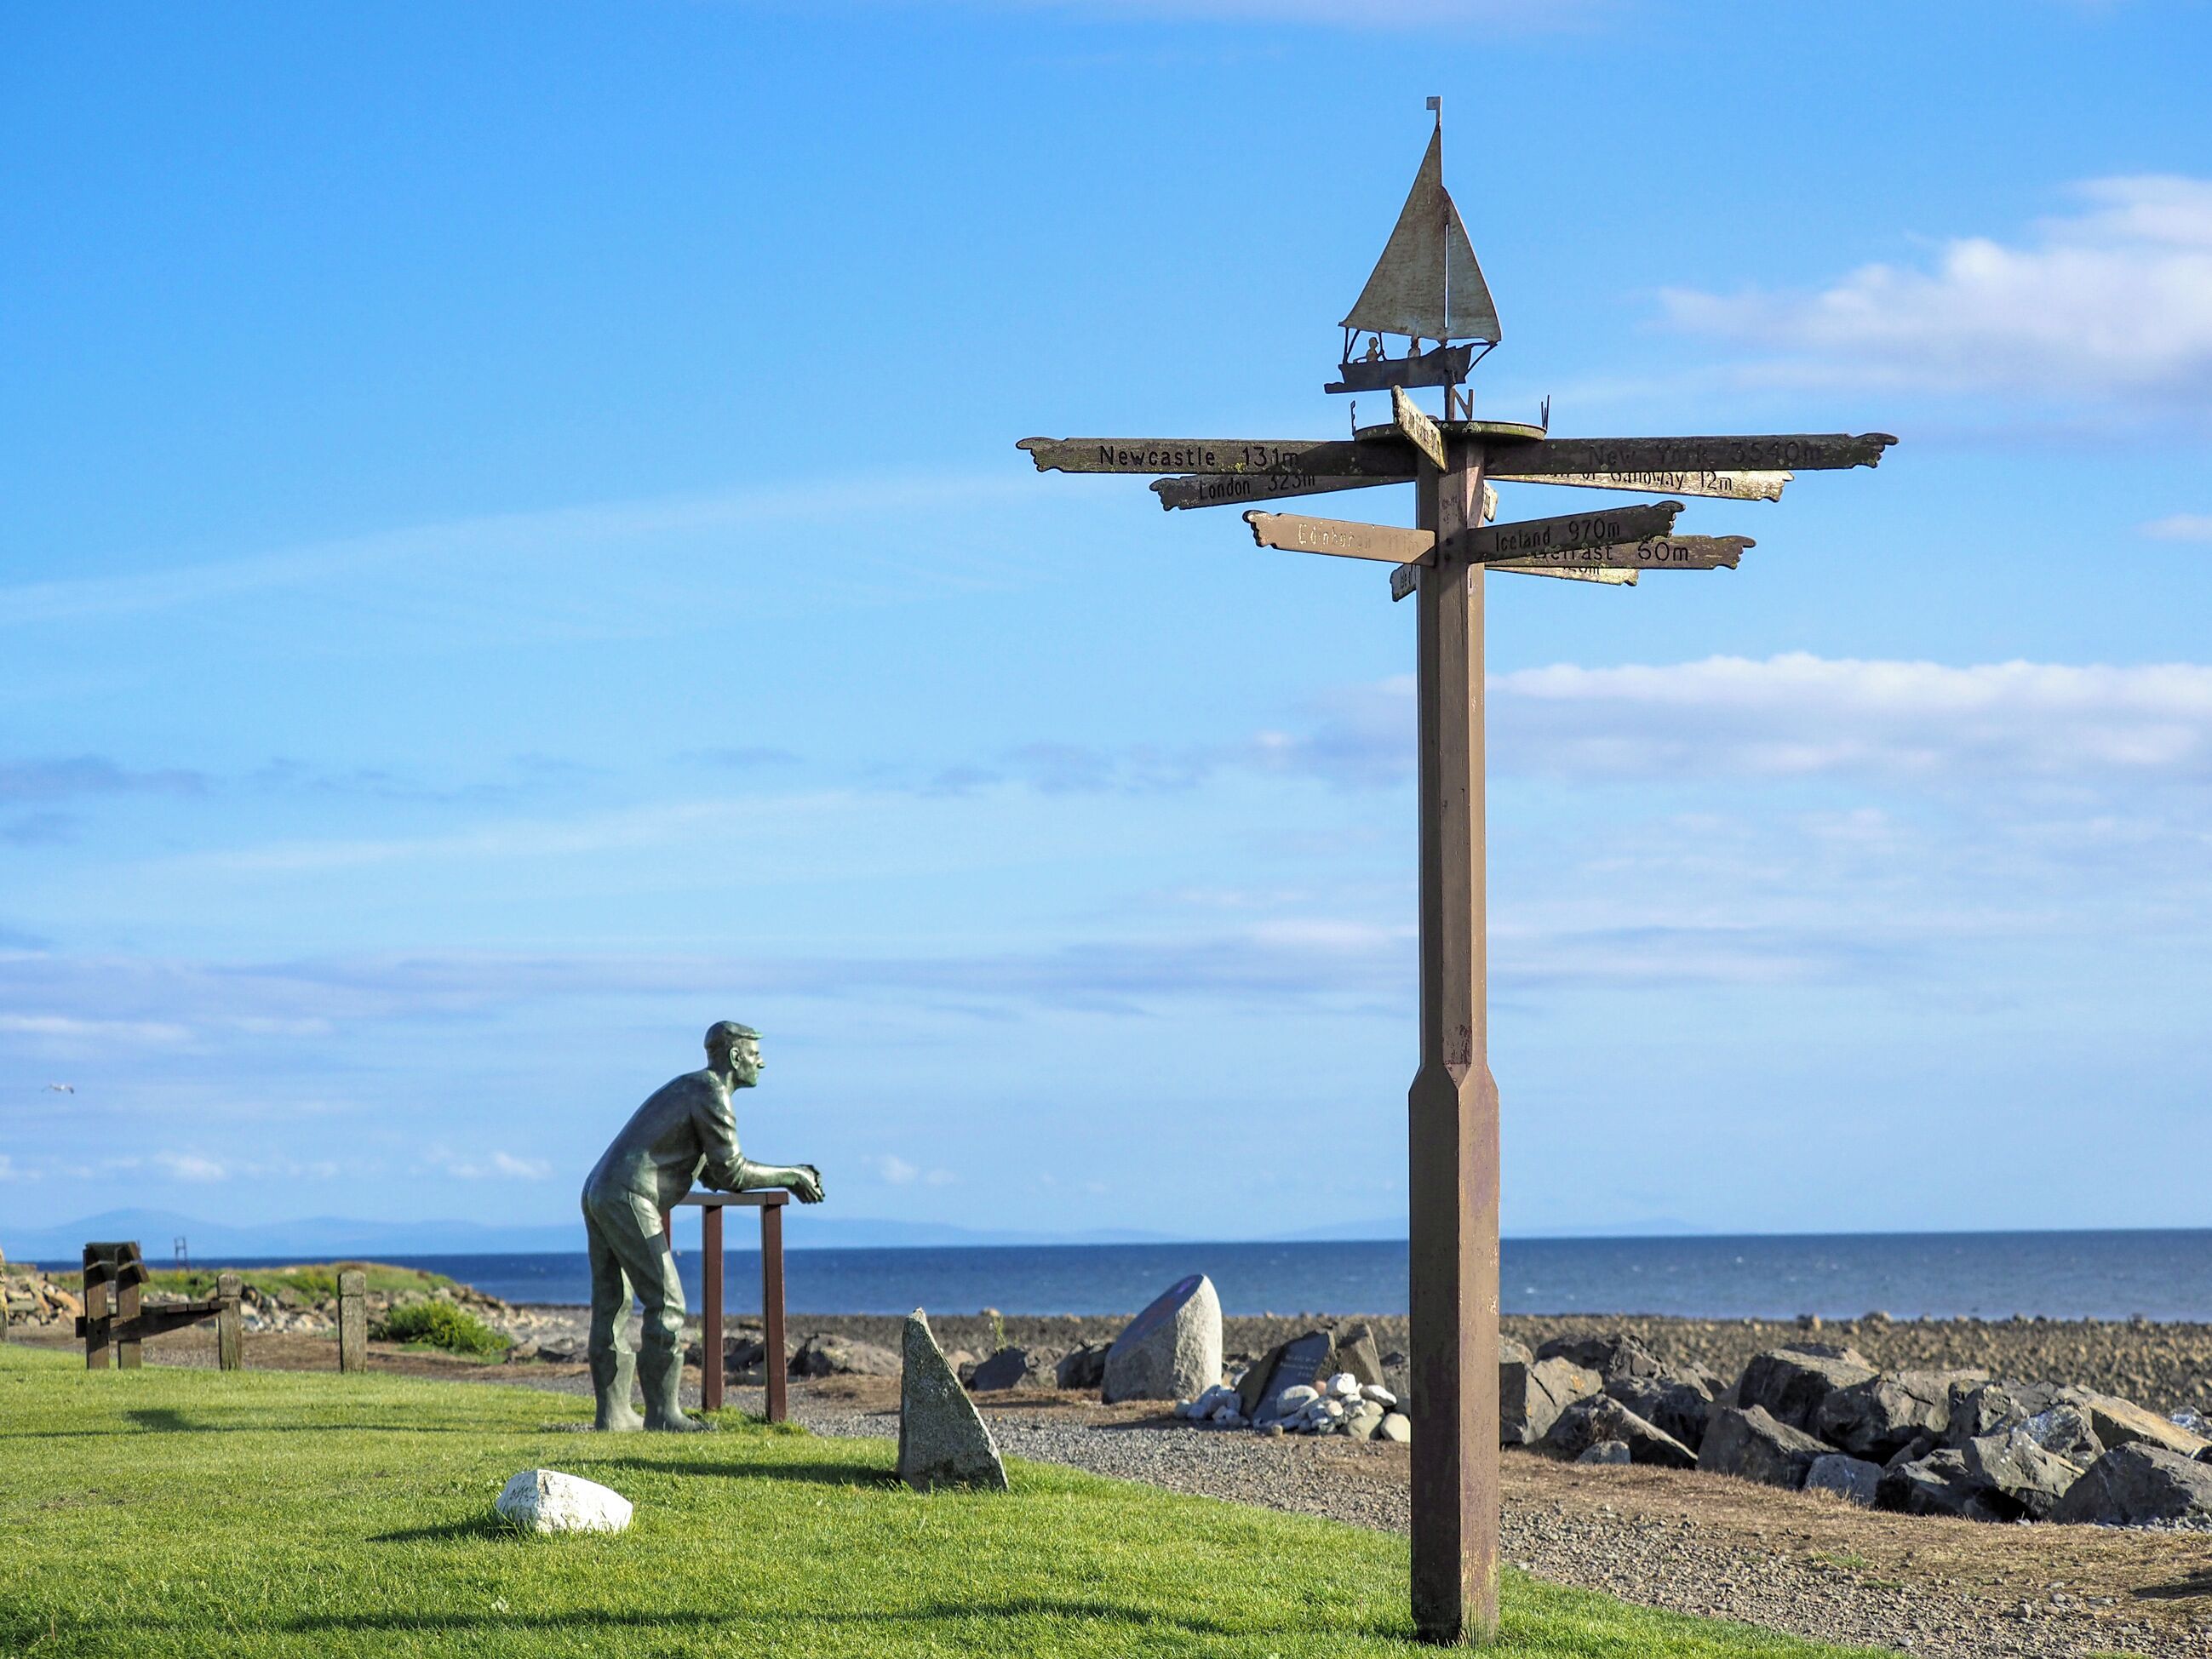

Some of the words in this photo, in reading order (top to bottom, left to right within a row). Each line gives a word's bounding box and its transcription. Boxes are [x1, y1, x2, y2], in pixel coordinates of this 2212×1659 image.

[1098, 445, 1216, 466] Newcastle
[1242, 446, 1299, 467] 131m
[1590, 444, 1636, 466] New
[1656, 443, 1710, 463] York
[1199, 478, 1251, 500] London
[1268, 474, 1316, 492] 323m
[1700, 471, 1733, 491] 12m
[1495, 525, 1551, 552] Iceland
[1568, 518, 1620, 541] 970m
[1534, 545, 1613, 561] east
[1637, 541, 1689, 561] 60m
